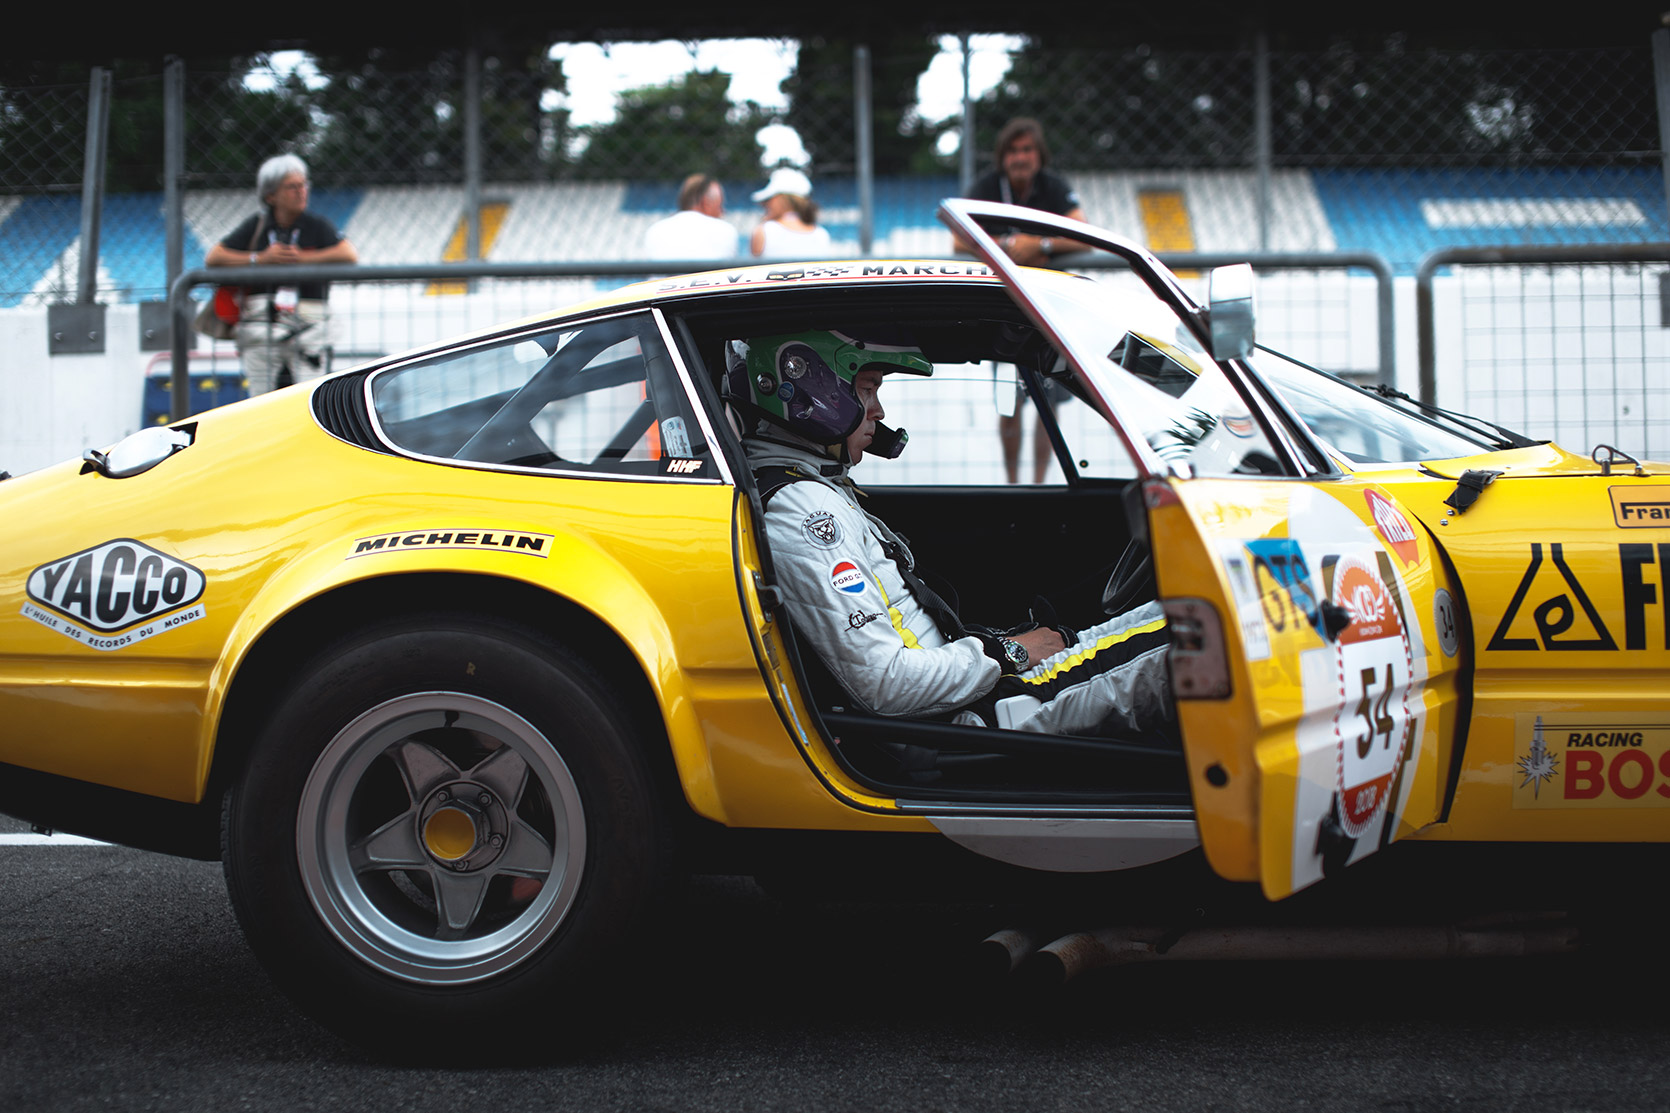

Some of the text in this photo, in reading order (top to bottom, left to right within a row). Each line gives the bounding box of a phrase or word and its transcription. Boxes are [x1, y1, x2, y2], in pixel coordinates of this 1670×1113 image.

[659, 265, 1000, 291] S.E.V. MARCH
[803, 511, 835, 529] JAGUAR
[355, 532, 545, 554] MICHELIN
[43, 545, 188, 623] YACCO
[832, 575, 854, 587] FORD
[1253, 554, 1318, 632] GTS
[24, 606, 201, 648] L'HUILE DES RECORDS DU MONDE
[1439, 605, 1456, 640] 34
[1355, 663, 1396, 760] 54
[1567, 732, 1644, 748] RACING
